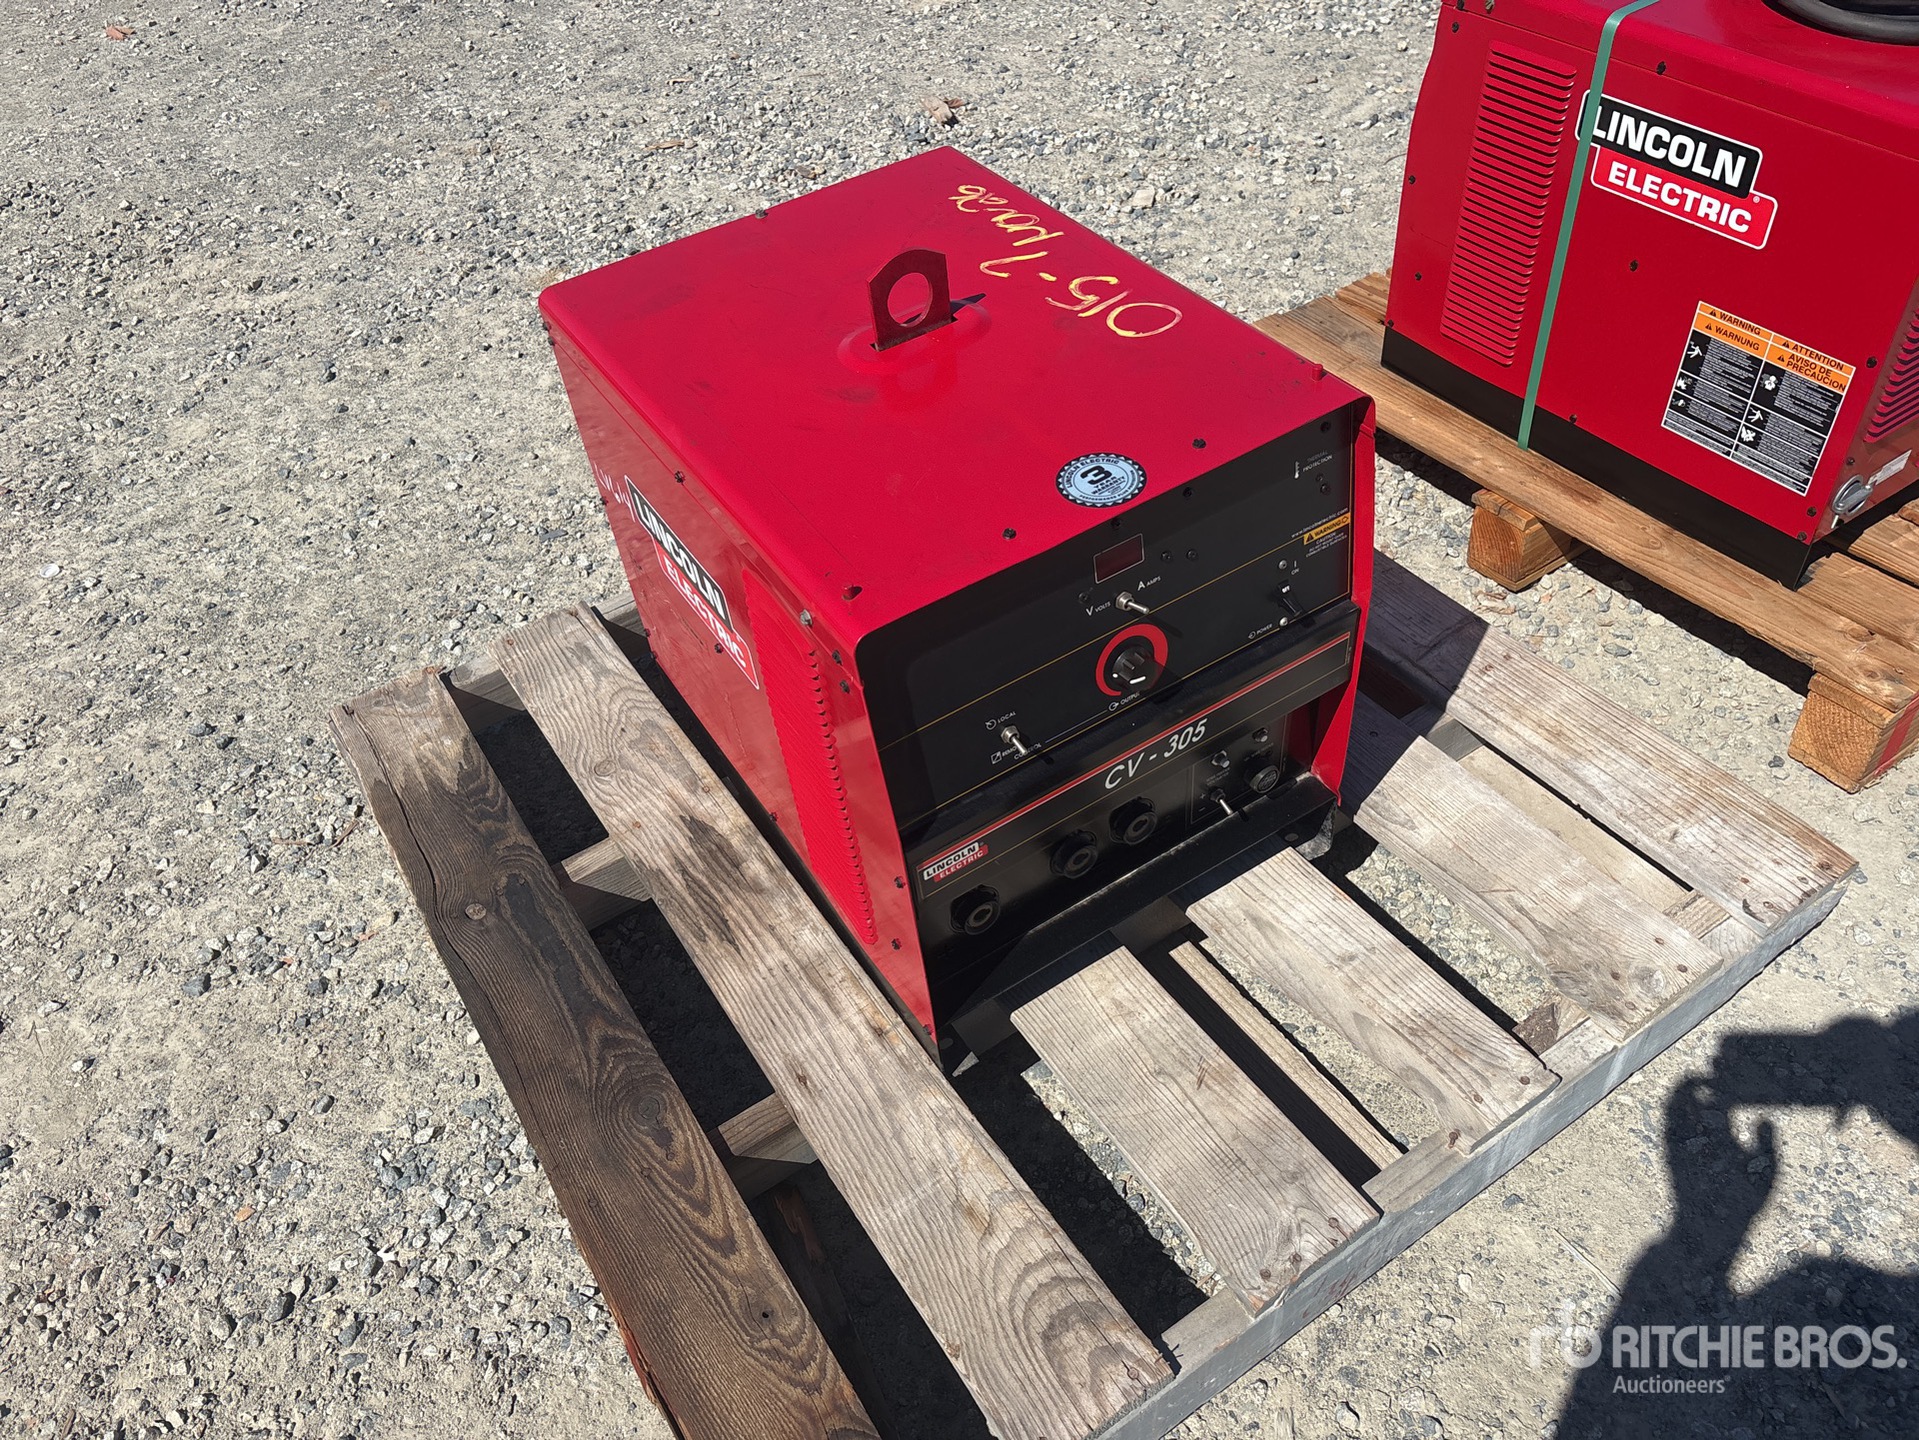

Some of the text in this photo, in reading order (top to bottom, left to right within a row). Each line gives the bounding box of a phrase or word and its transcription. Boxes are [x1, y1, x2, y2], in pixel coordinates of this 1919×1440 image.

[1592, 105, 1747, 188] LINCOLN
[1607, 160, 1752, 233] ELECTRIC
[1719, 311, 1761, 336] WARNING
[1715, 325, 1760, 351] WARNUNG
[1788, 353, 1833, 378] AVISO DE
[1791, 343, 1844, 371] ATTENTION
[1786, 360, 1847, 392] PRECAUCION
[1080, 465, 1113, 486] 3
[633, 492, 726, 620] LINCOLN
[1137, 576, 1162, 591] A AMPS
[663, 554, 747, 668] ELECTRIC
[1085, 601, 1112, 616] V VOLTS
[998, 711, 1016, 724] LOCAL
[1104, 752, 1146, 789] CV
[1163, 718, 1208, 758] 305
[926, 845, 976, 877] LINCOLN
[939, 850, 984, 879] ELECTRIC
